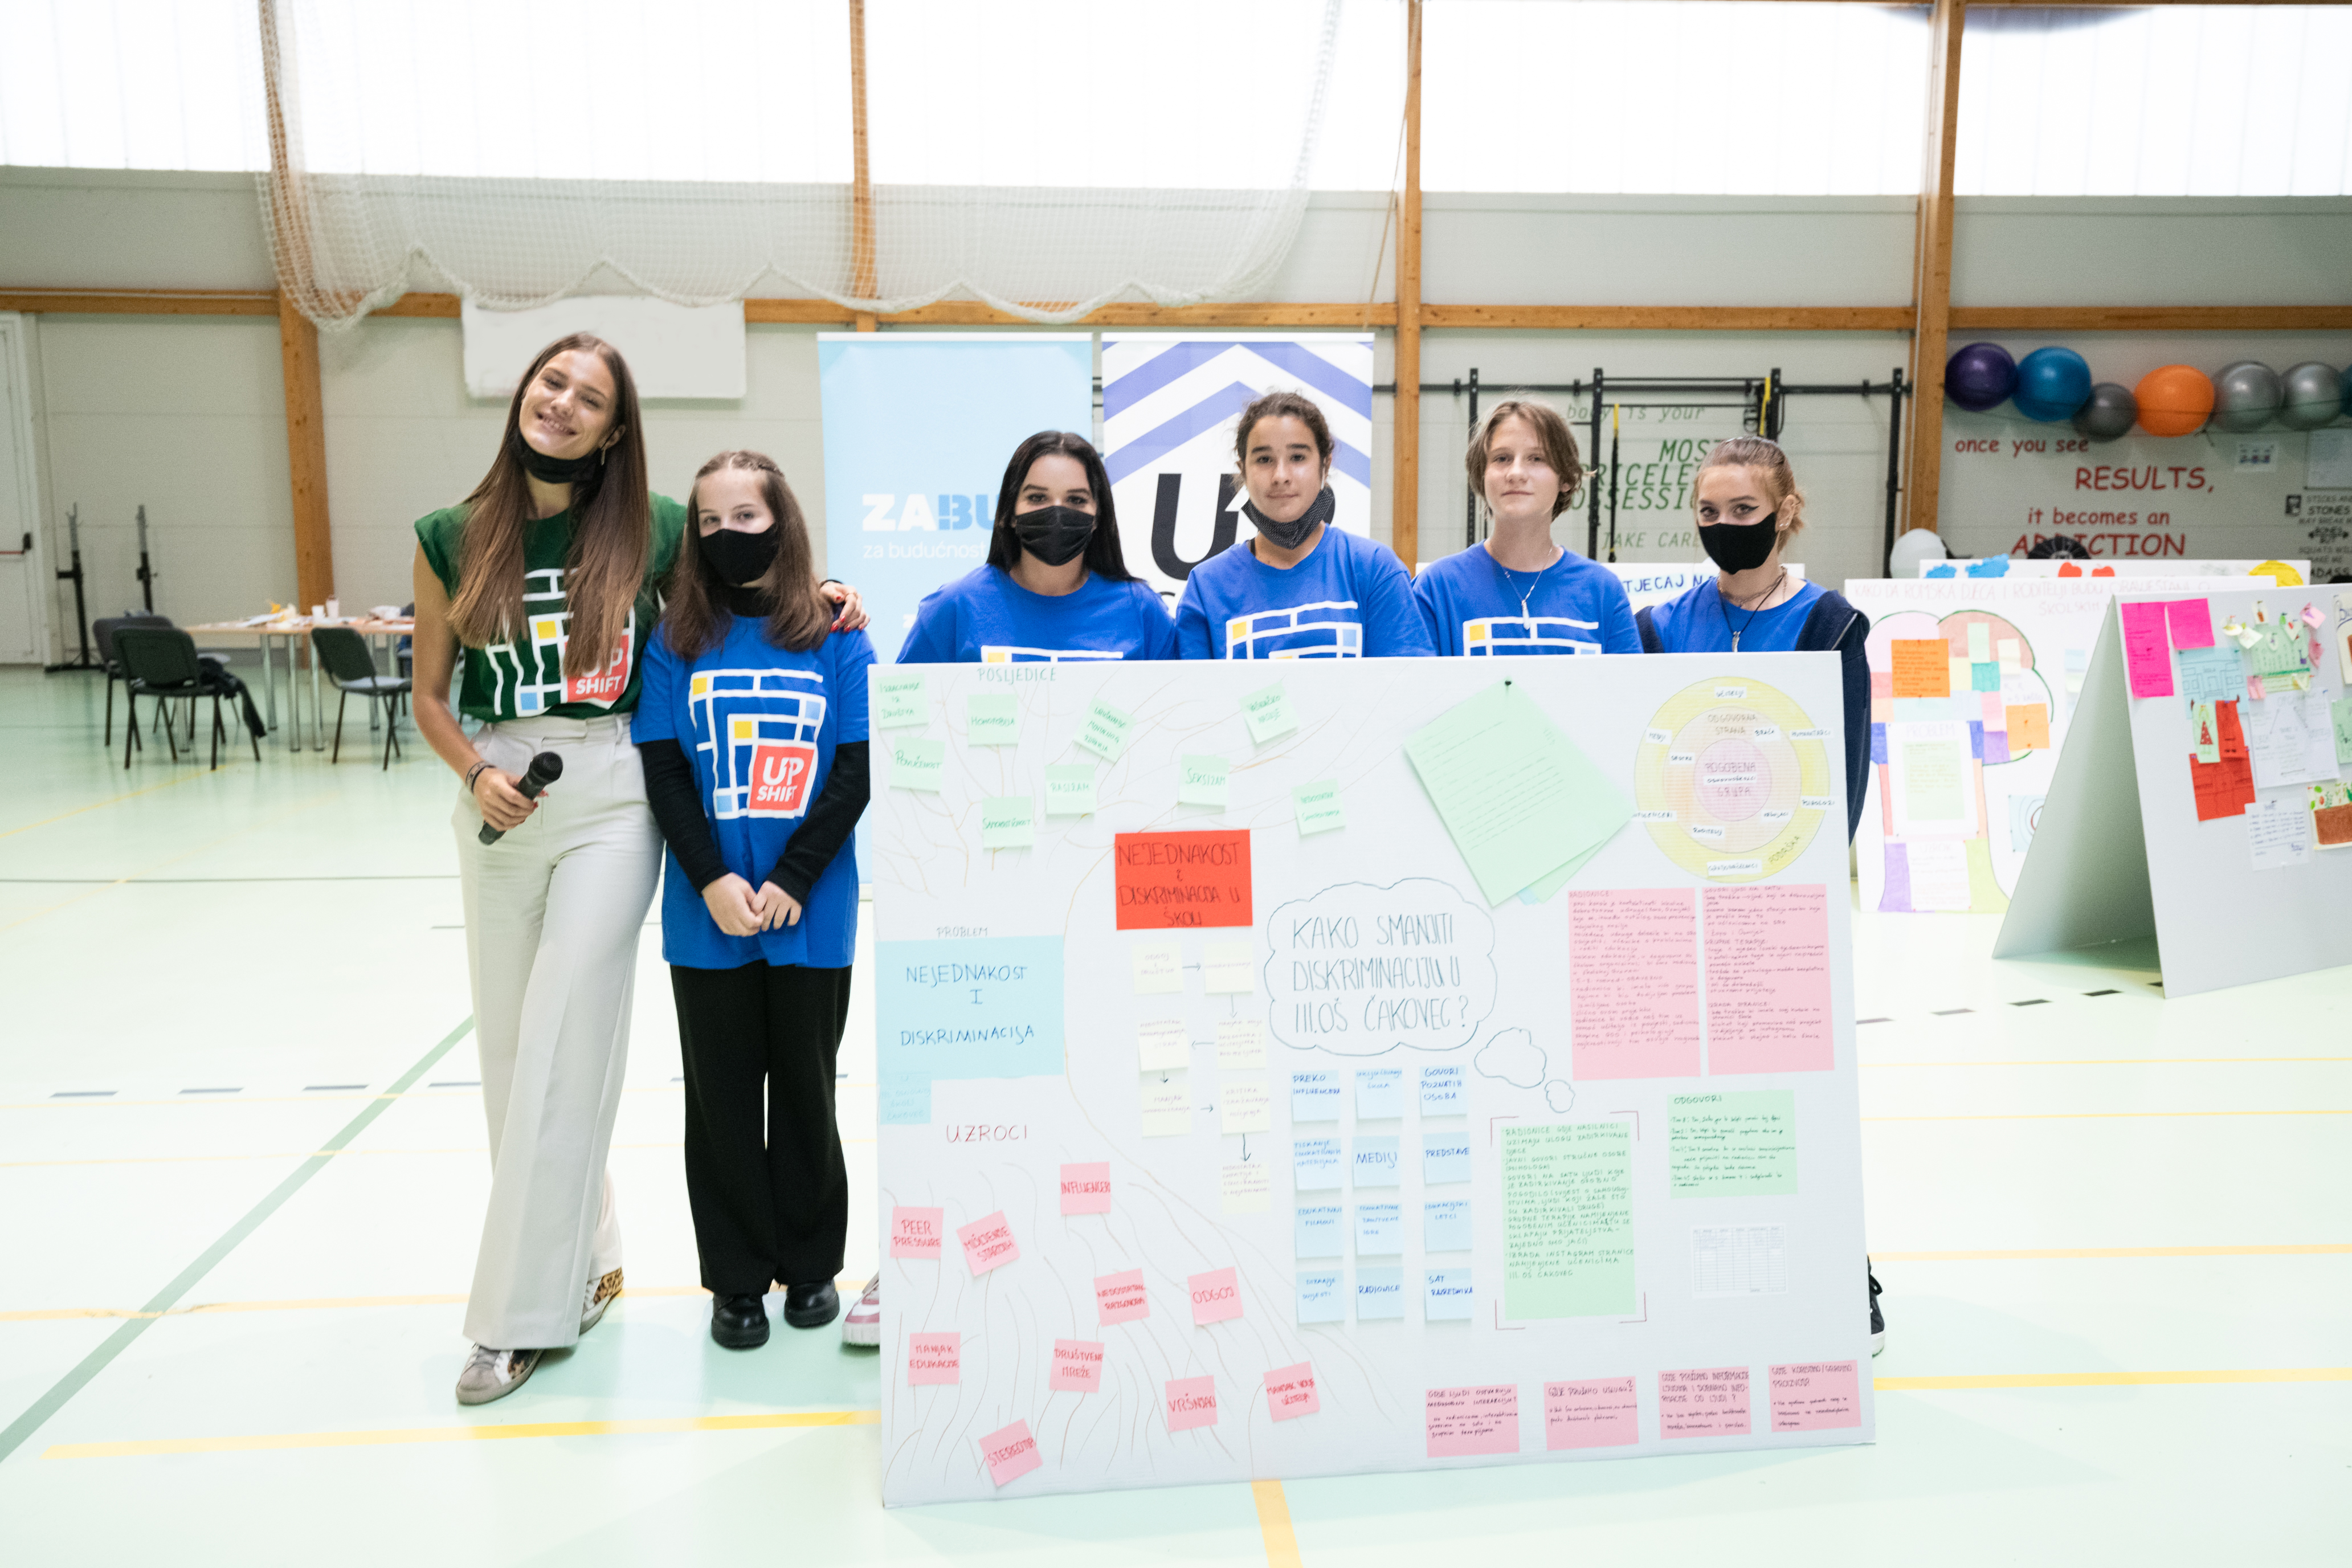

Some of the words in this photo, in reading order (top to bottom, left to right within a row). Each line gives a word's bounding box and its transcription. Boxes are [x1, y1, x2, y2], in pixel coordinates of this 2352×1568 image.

[1568, 404, 1611, 422] boy
[1659, 407, 1705, 423] your
[1659, 439, 1725, 462] MOS
[1955, 437, 1999, 453] once
[2013, 439, 2047, 458] you
[2056, 437, 2089, 453] see
[2076, 467, 2214, 493] RESULTS,
[2028, 507, 2043, 524] it
[2053, 507, 2137, 524] becomes
[2147, 512, 2170, 525] an
[863, 545, 883, 558] za
[889, 541, 986, 558] budućnost
[1855, 583, 1881, 597] KAKO
[1885, 584, 1898, 598] DA
[1905, 583, 1955, 600] ROMSKA
[1961, 583, 1995, 601] DJECA
[2072, 582, 2103, 596] BUDU
[977, 667, 1057, 685] POSLJEDICE
[575, 675, 622, 695] SHIFT
[763, 756, 805, 786] UP
[757, 785, 798, 802] SHIFT
[1118, 843, 1239, 866] NEJEDNAKOST
[1118, 885, 1220, 906] DISKRIMINACIJA
[1230, 887, 1240, 903] U
[936, 926, 988, 938] PROBLEM
[1293, 916, 1358, 949] KAKO
[1377, 913, 1453, 946] SMANJITI
[906, 963, 1027, 989] NEJEDNAKOST
[1292, 957, 1446, 991] DISKRIMINACIJU
[1450, 956, 1460, 987] U
[970, 989, 983, 1004] I
[1365, 994, 1451, 1031] ČAKOVEC
[901, 1024, 1034, 1046] DISKRIMINACIJA
[1293, 1074, 1326, 1083] PREKO
[1425, 1068, 1458, 1077] GOVORI
[1674, 1095, 1722, 1104] ODGOVORI
[946, 1124, 1027, 1143] UZROCI
[1505, 1126, 1550, 1137] RADIONICE
[1557, 1125, 1572, 1134] GDJE
[1506, 1138, 1540, 1147] UZIMAJU
[1355, 1152, 1397, 1169] MEDIJI
[1426, 1147, 1470, 1158] PREDSTAVE
[1505, 1157, 1526, 1165] JAVNI
[1563, 1152, 1598, 1160] STRUČNE
[1582, 1170, 1603, 1178] LJUDI
[1542, 1214, 1575, 1223] TERAPIJE
[901, 1219, 932, 1236] PEER
[1509, 1231, 1547, 1240] SKLAPAJU
[893, 1236, 942, 1248] PRESSURE
[1429, 1275, 1445, 1284] SAT
[1193, 1286, 1235, 1304] ODGOJ
[1358, 1284, 1400, 1295] RADIONICE
[916, 1345, 954, 1357] MANJAK
[1054, 1348, 1104, 1362] DRUŠTVENE
